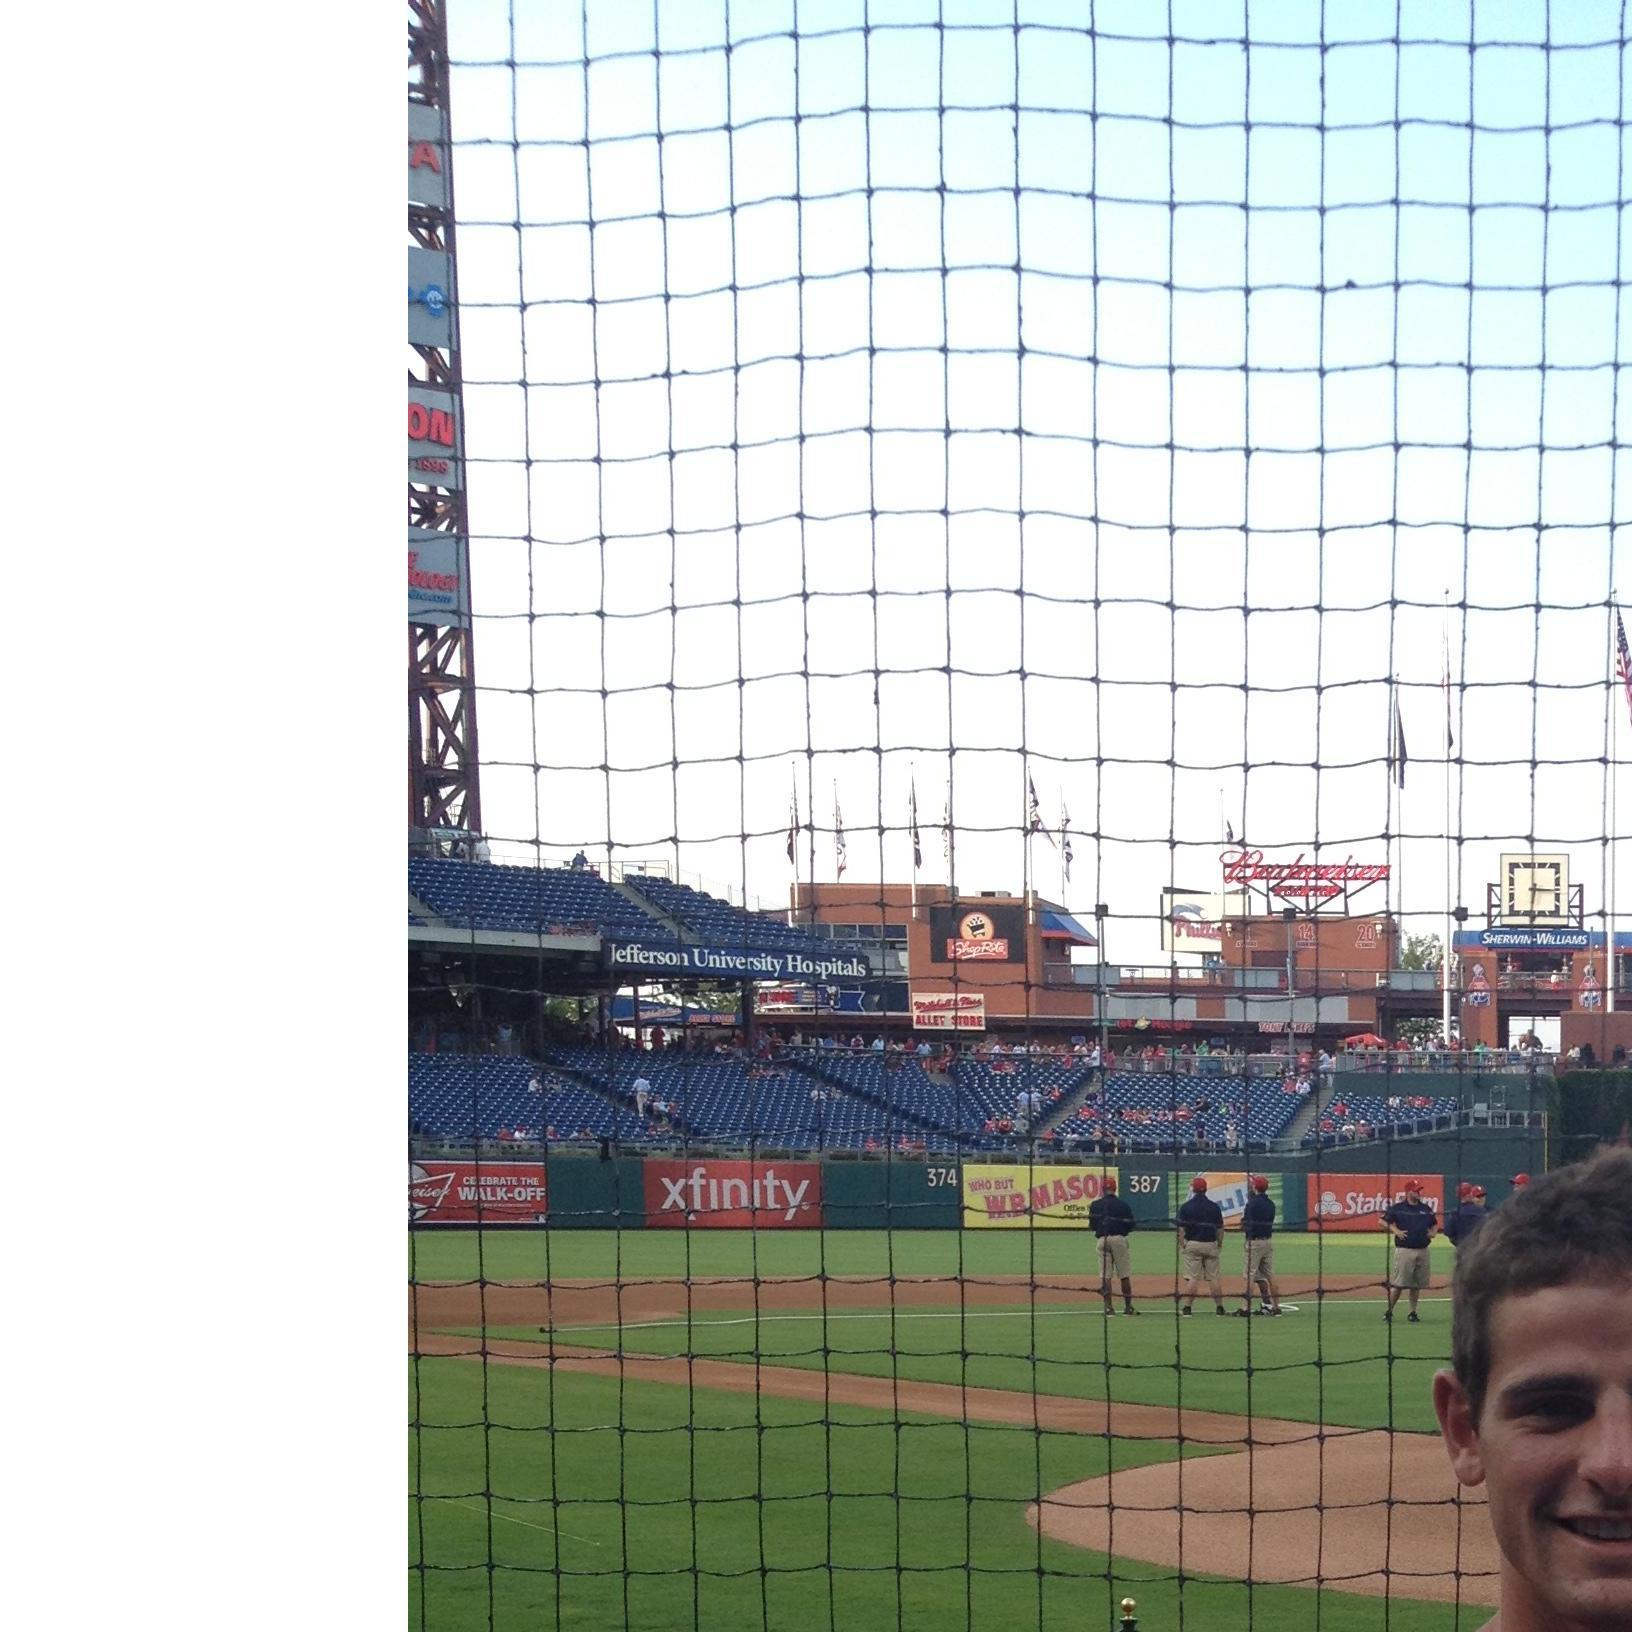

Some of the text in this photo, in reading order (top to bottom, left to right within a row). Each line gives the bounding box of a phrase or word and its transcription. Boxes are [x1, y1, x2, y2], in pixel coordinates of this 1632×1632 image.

[1357, 923, 1376, 942] 20
[1481, 931, 1588, 946] SHERWIN-WILLIAMS
[611, 943, 867, 979] Jefferson University Hospitals
[951, 1015, 983, 1027] STORE
[463, 1177, 539, 1186] CELEBRATE THE
[927, 1168, 957, 1187] 374
[969, 1179, 1014, 1192] WHO BUT
[1129, 1176, 1160, 1193] 387
[458, 1186, 546, 1201] WALK-OFF
[660, 1167, 810, 1221] xfinity
